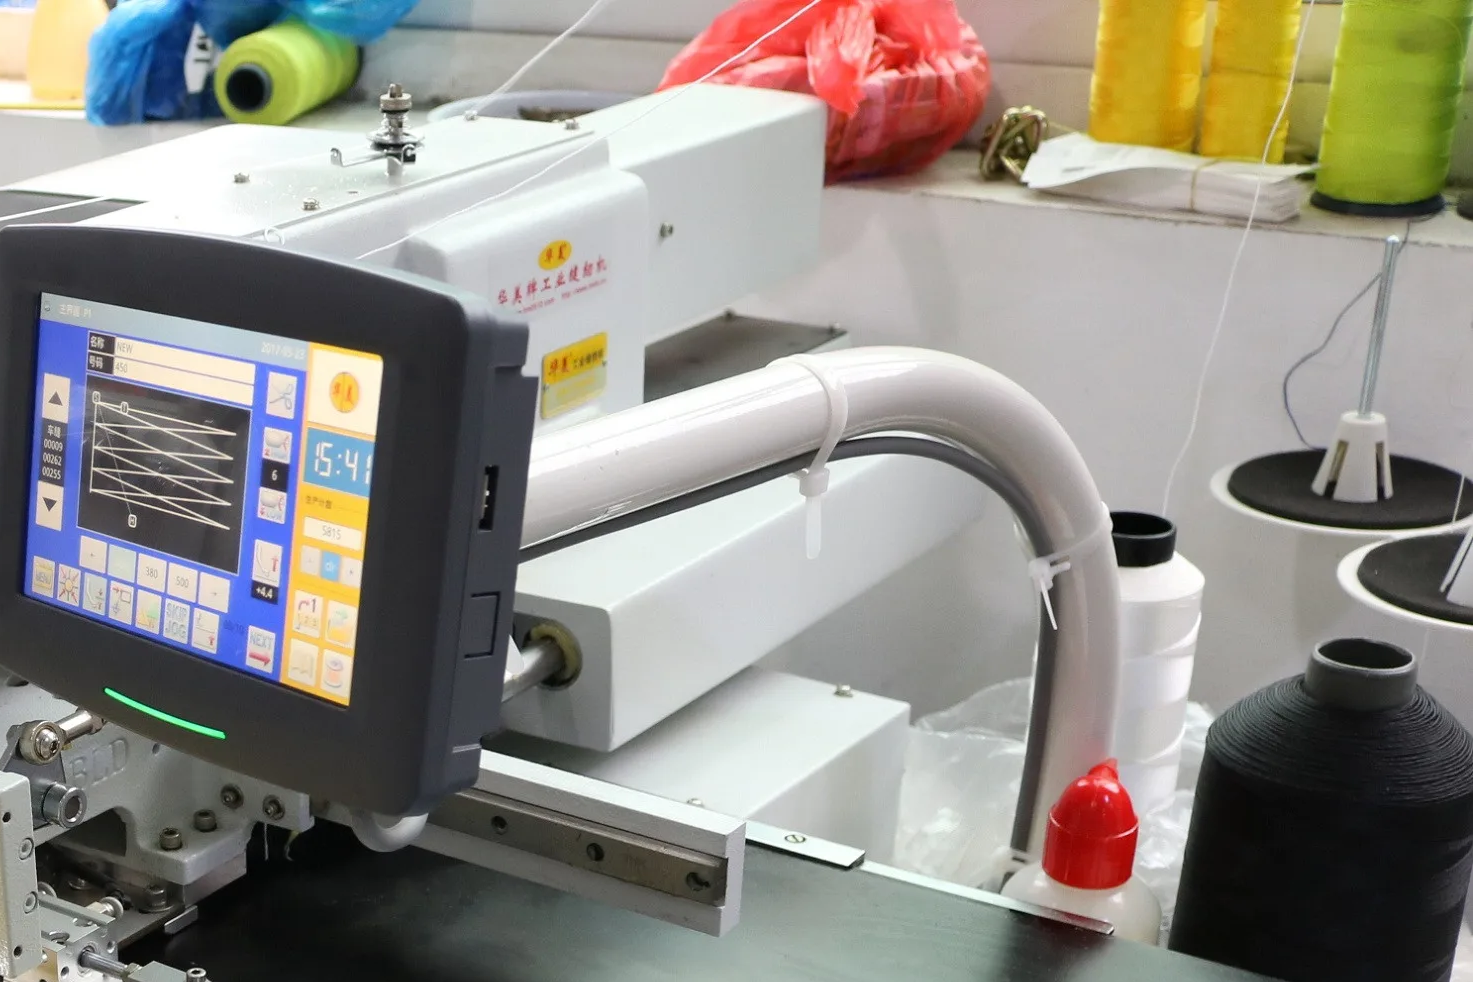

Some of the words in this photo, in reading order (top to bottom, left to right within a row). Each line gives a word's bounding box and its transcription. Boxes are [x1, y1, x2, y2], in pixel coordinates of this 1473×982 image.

[89, 335, 105, 350] 名称
[117, 341, 134, 354] NEW
[43, 438, 64, 452] 00009
[42, 452, 63, 467] 00262
[315, 441, 373, 485] 15:41
[41, 466, 62, 480] 00255
[271, 469, 278, 481] 6
[145, 566, 159, 579] 380
[176, 576, 190, 589] 500
